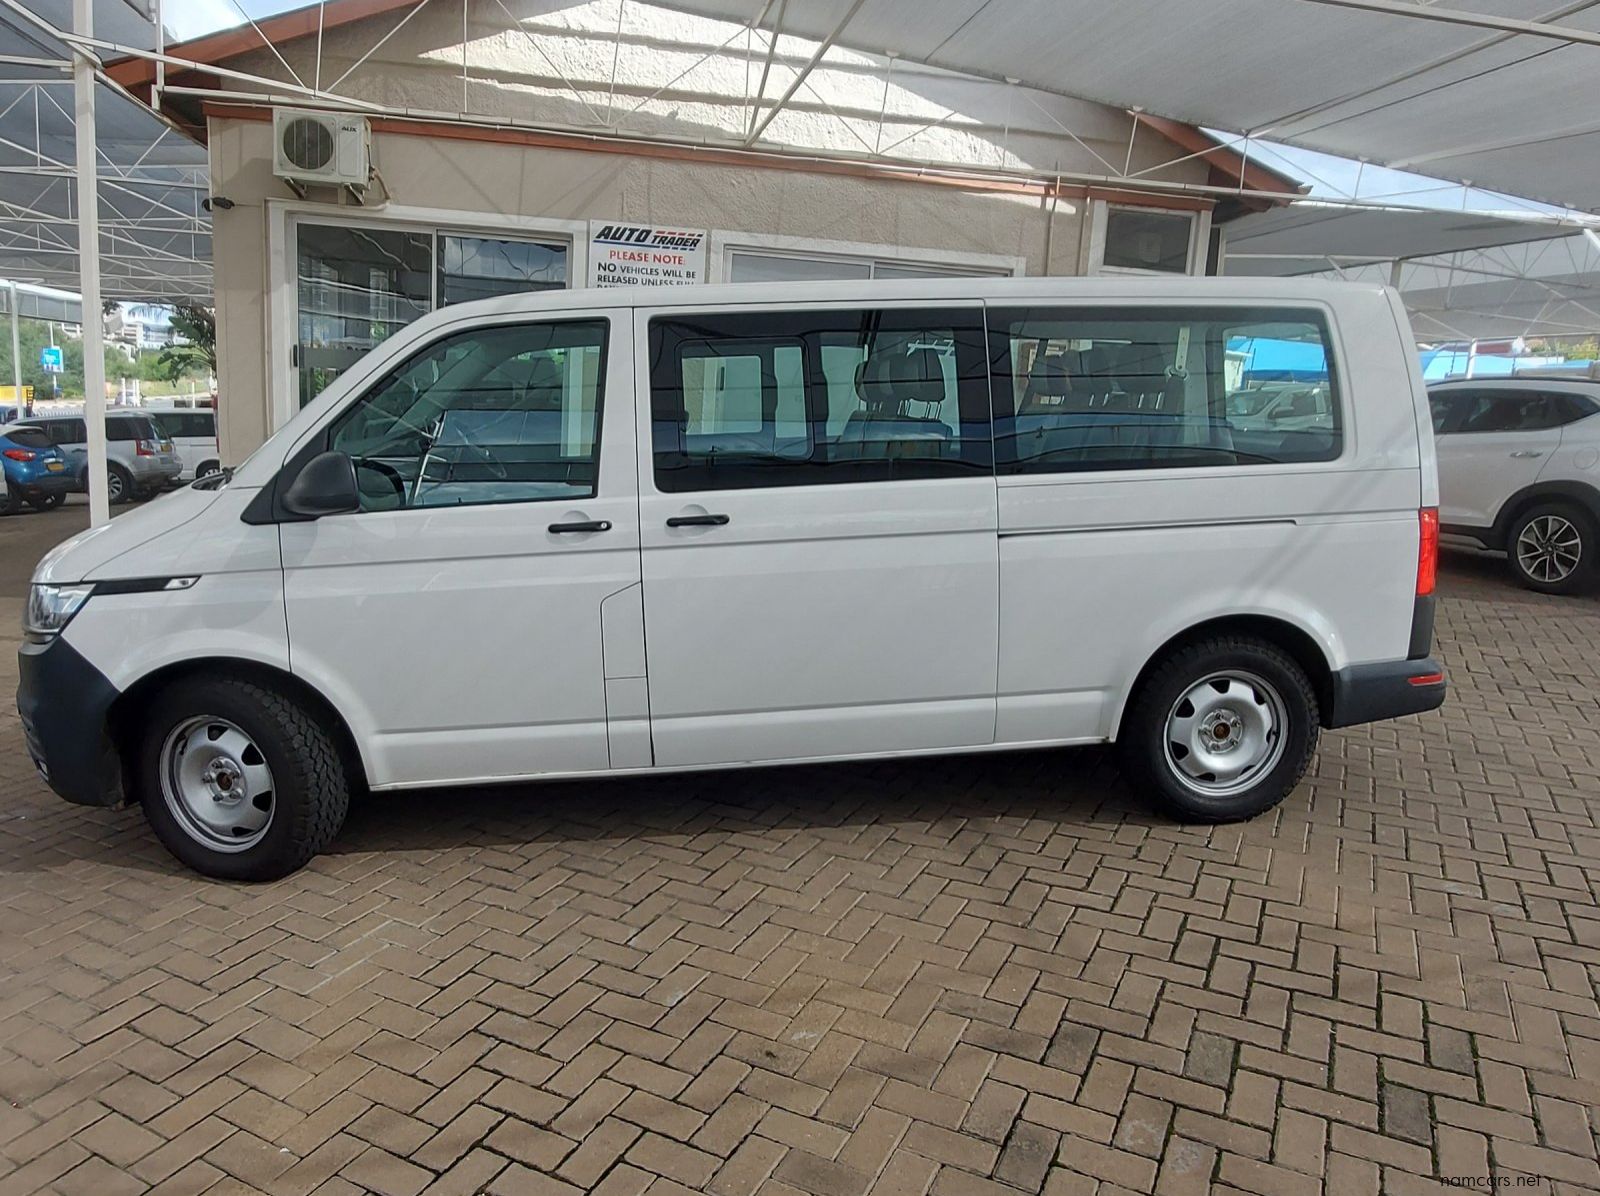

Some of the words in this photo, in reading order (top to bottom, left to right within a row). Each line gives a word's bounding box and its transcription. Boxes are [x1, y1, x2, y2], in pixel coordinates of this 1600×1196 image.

[596, 225, 652, 242] AUTO
[651, 235, 700, 247] TRADER
[609, 250, 649, 262] PLEASE
[597, 262, 617, 272] NO
[619, 265, 659, 276] VEHICLES
[662, 269, 682, 278] WILL
[686, 271, 696, 279] BE
[597, 274, 638, 285] RELEASED
